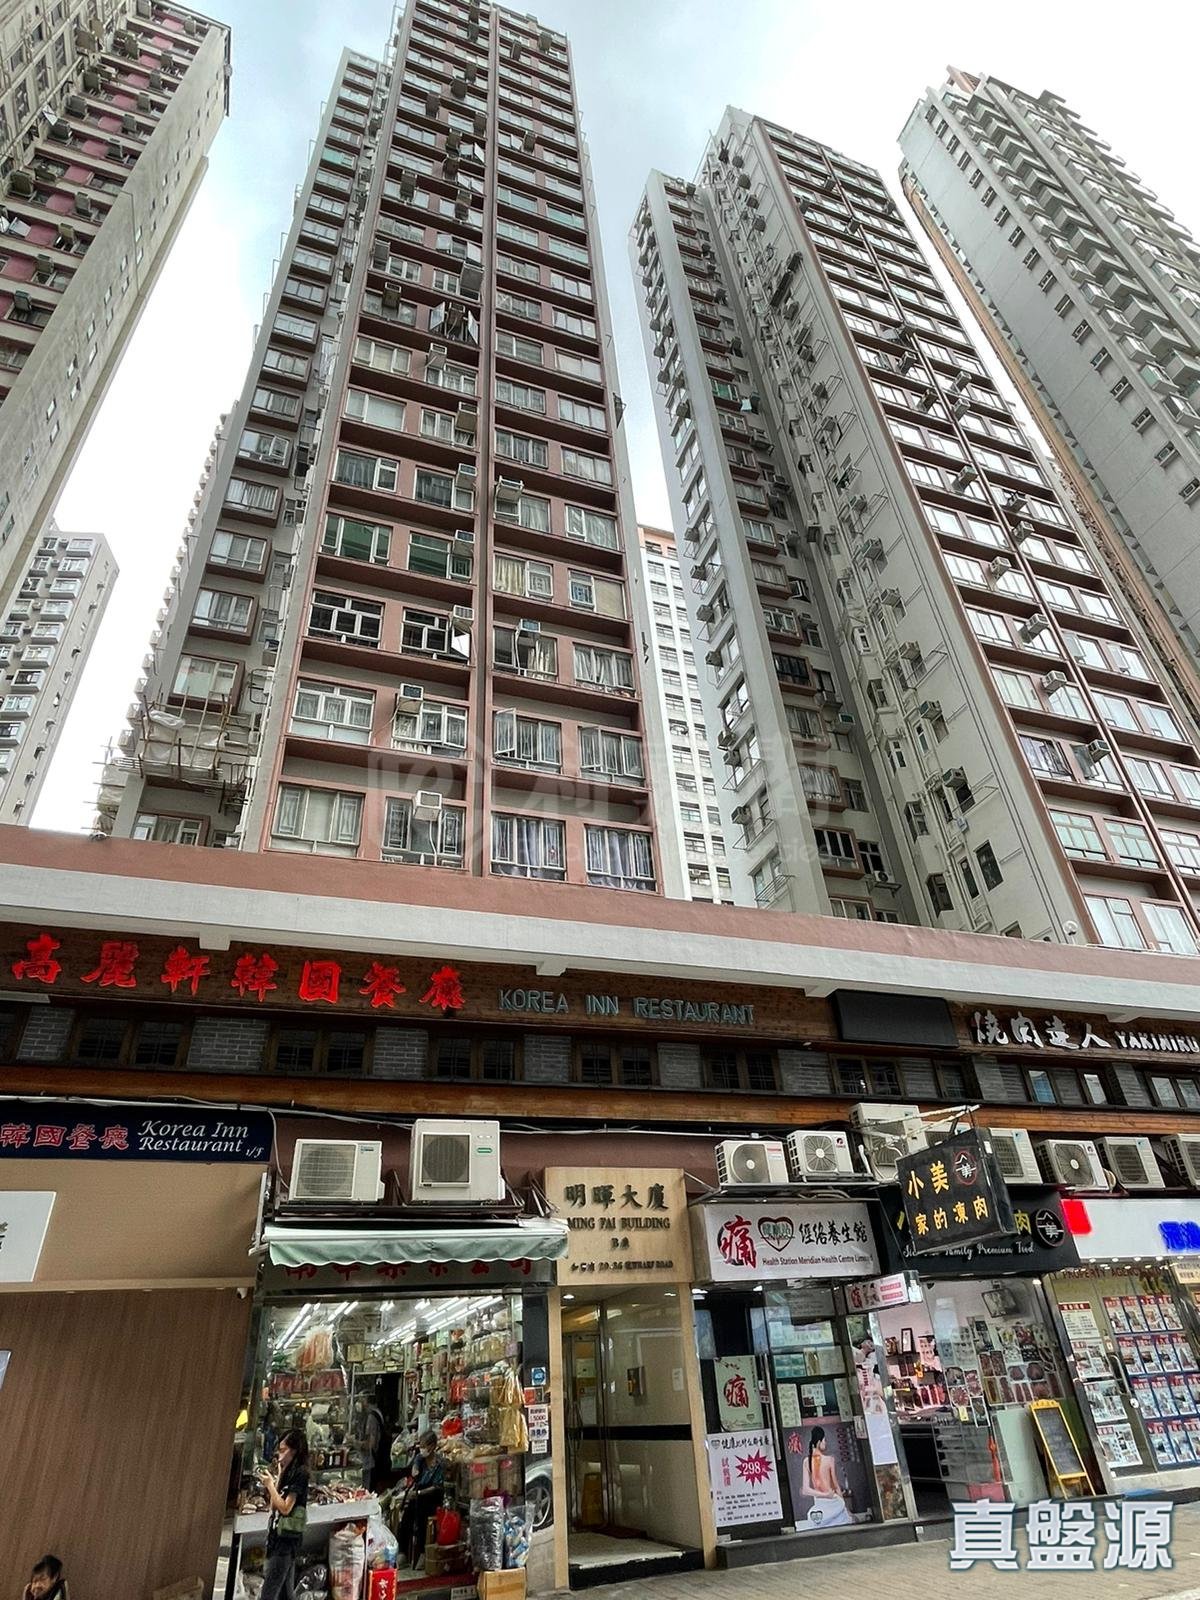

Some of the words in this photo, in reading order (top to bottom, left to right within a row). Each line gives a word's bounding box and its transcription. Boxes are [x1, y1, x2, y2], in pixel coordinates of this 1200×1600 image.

[500, 988, 569, 1014] KOREA
[586, 995, 619, 1016] INN
[634, 997, 755, 1025] RESTAURANT
[138, 1119, 206, 1138] Korea
[210, 1121, 249, 1139] Inn
[138, 1136, 244, 1153] Restaurant
[907, 1160, 951, 1200] 小美
[567, 1217, 596, 1231] MING
[621, 1216, 671, 1230] BUILDING
[762, 1258, 779, 1266] Health
[780, 1257, 798, 1265] Station
[799, 1256, 821, 1265] Meridian
[822, 1256, 838, 1264] Health
